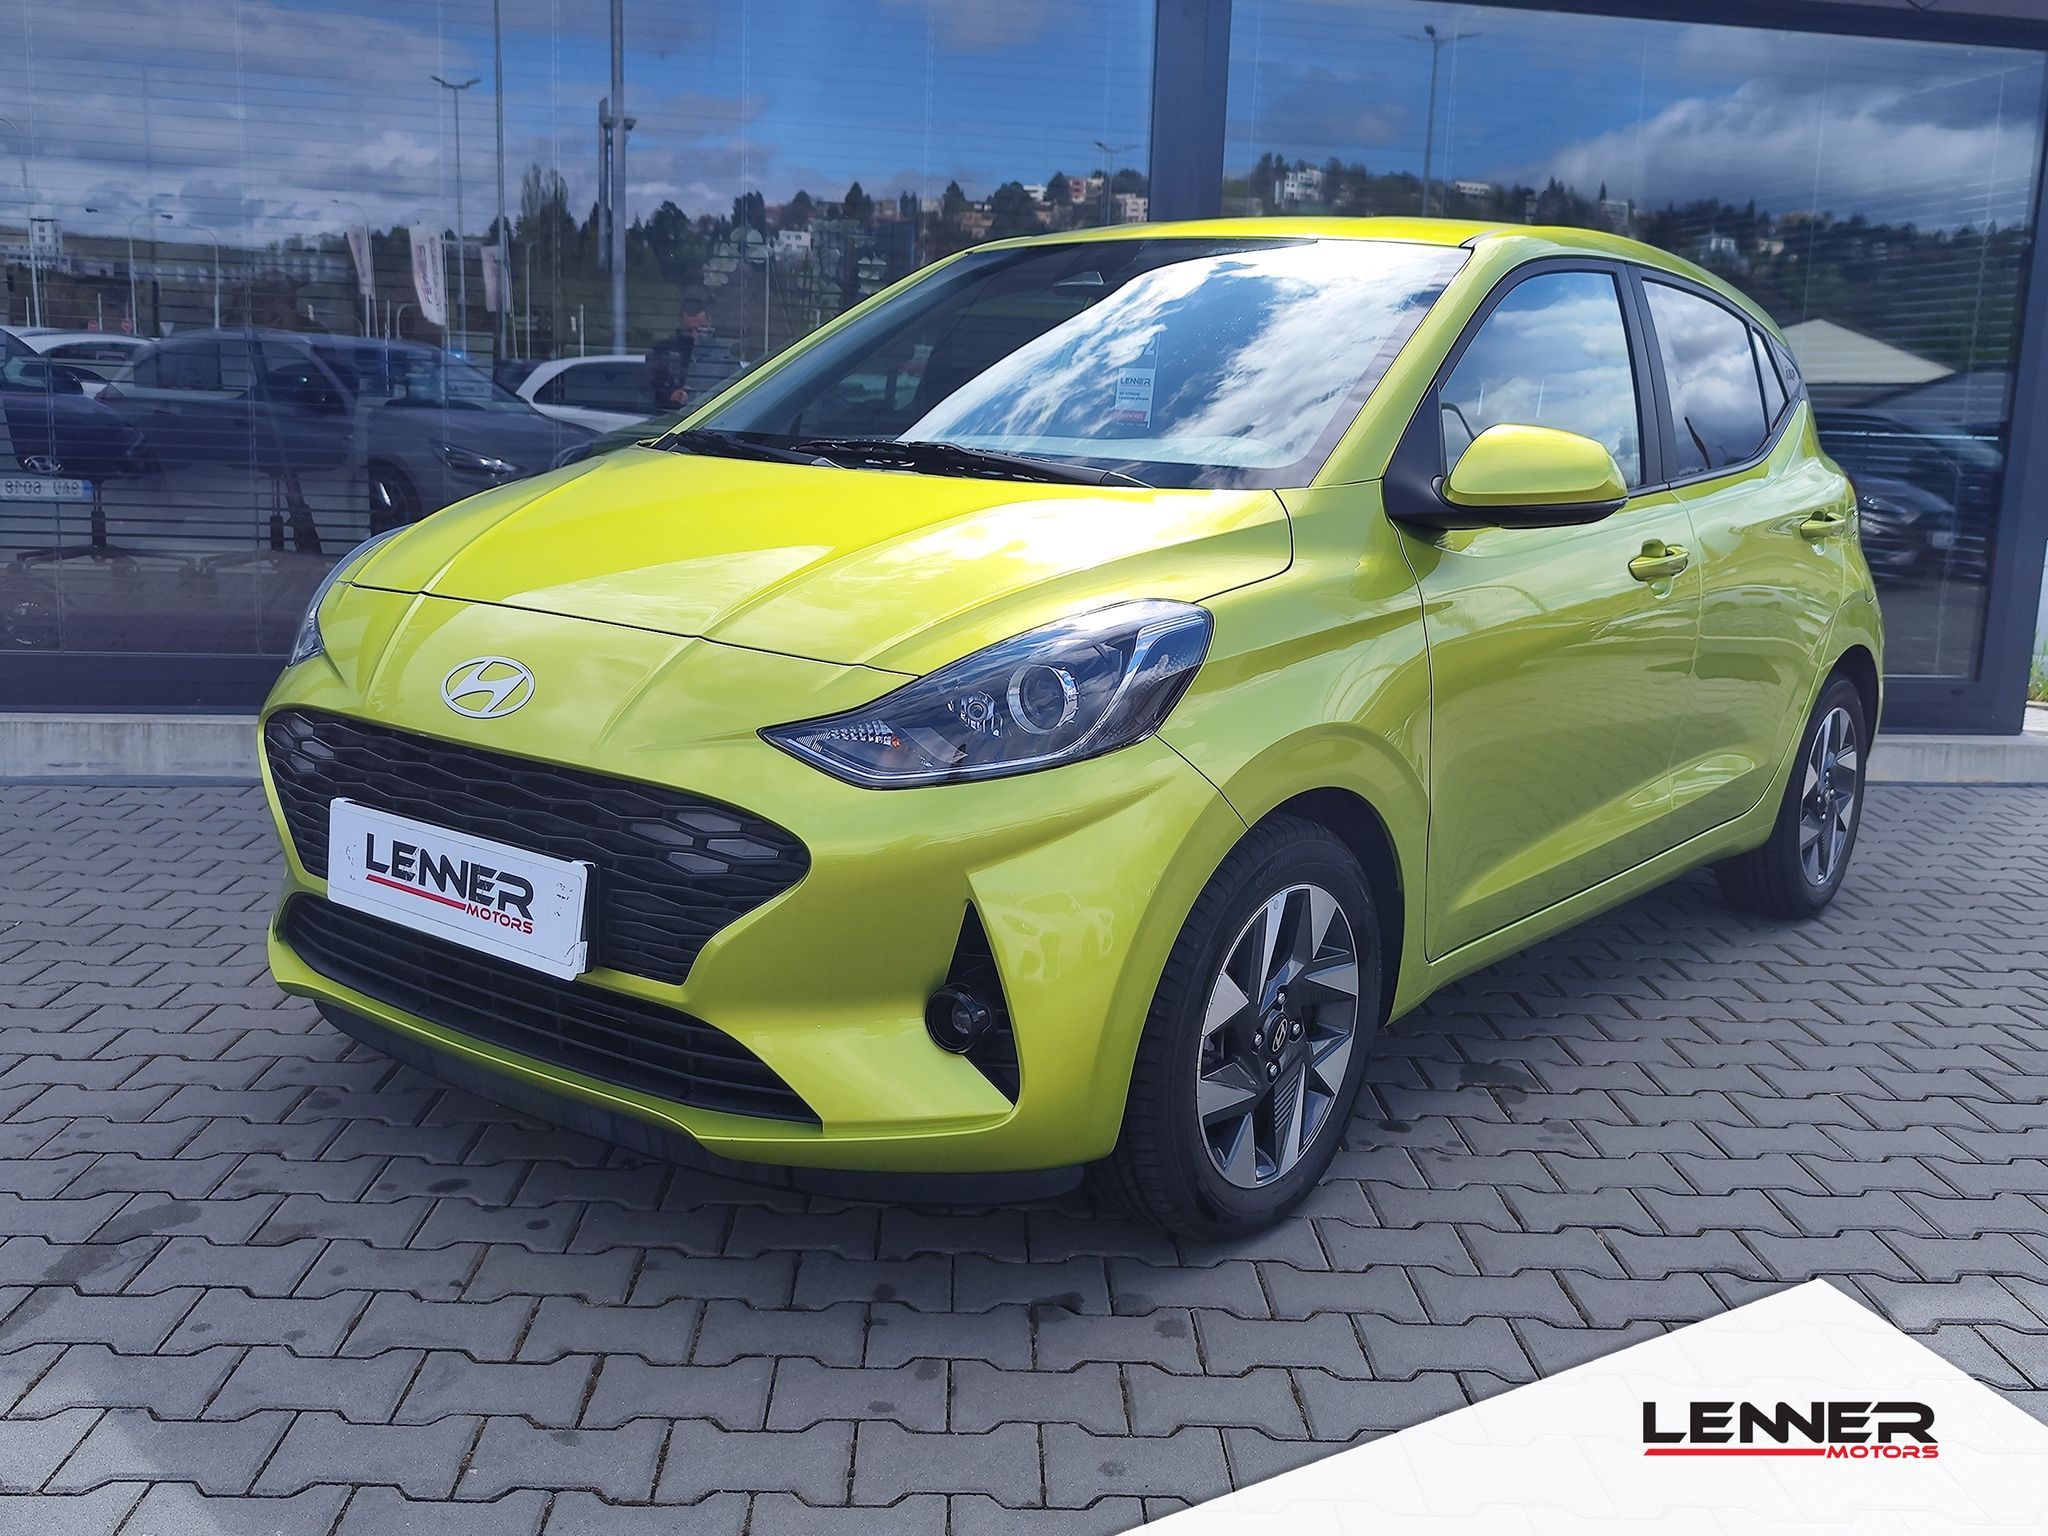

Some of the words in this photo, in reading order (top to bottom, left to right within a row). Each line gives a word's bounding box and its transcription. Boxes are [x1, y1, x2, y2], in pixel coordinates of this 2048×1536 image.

[1120, 377, 1151, 386] LENNER
[365, 832, 534, 921] LENNER
[466, 902, 533, 935] MOTORS
